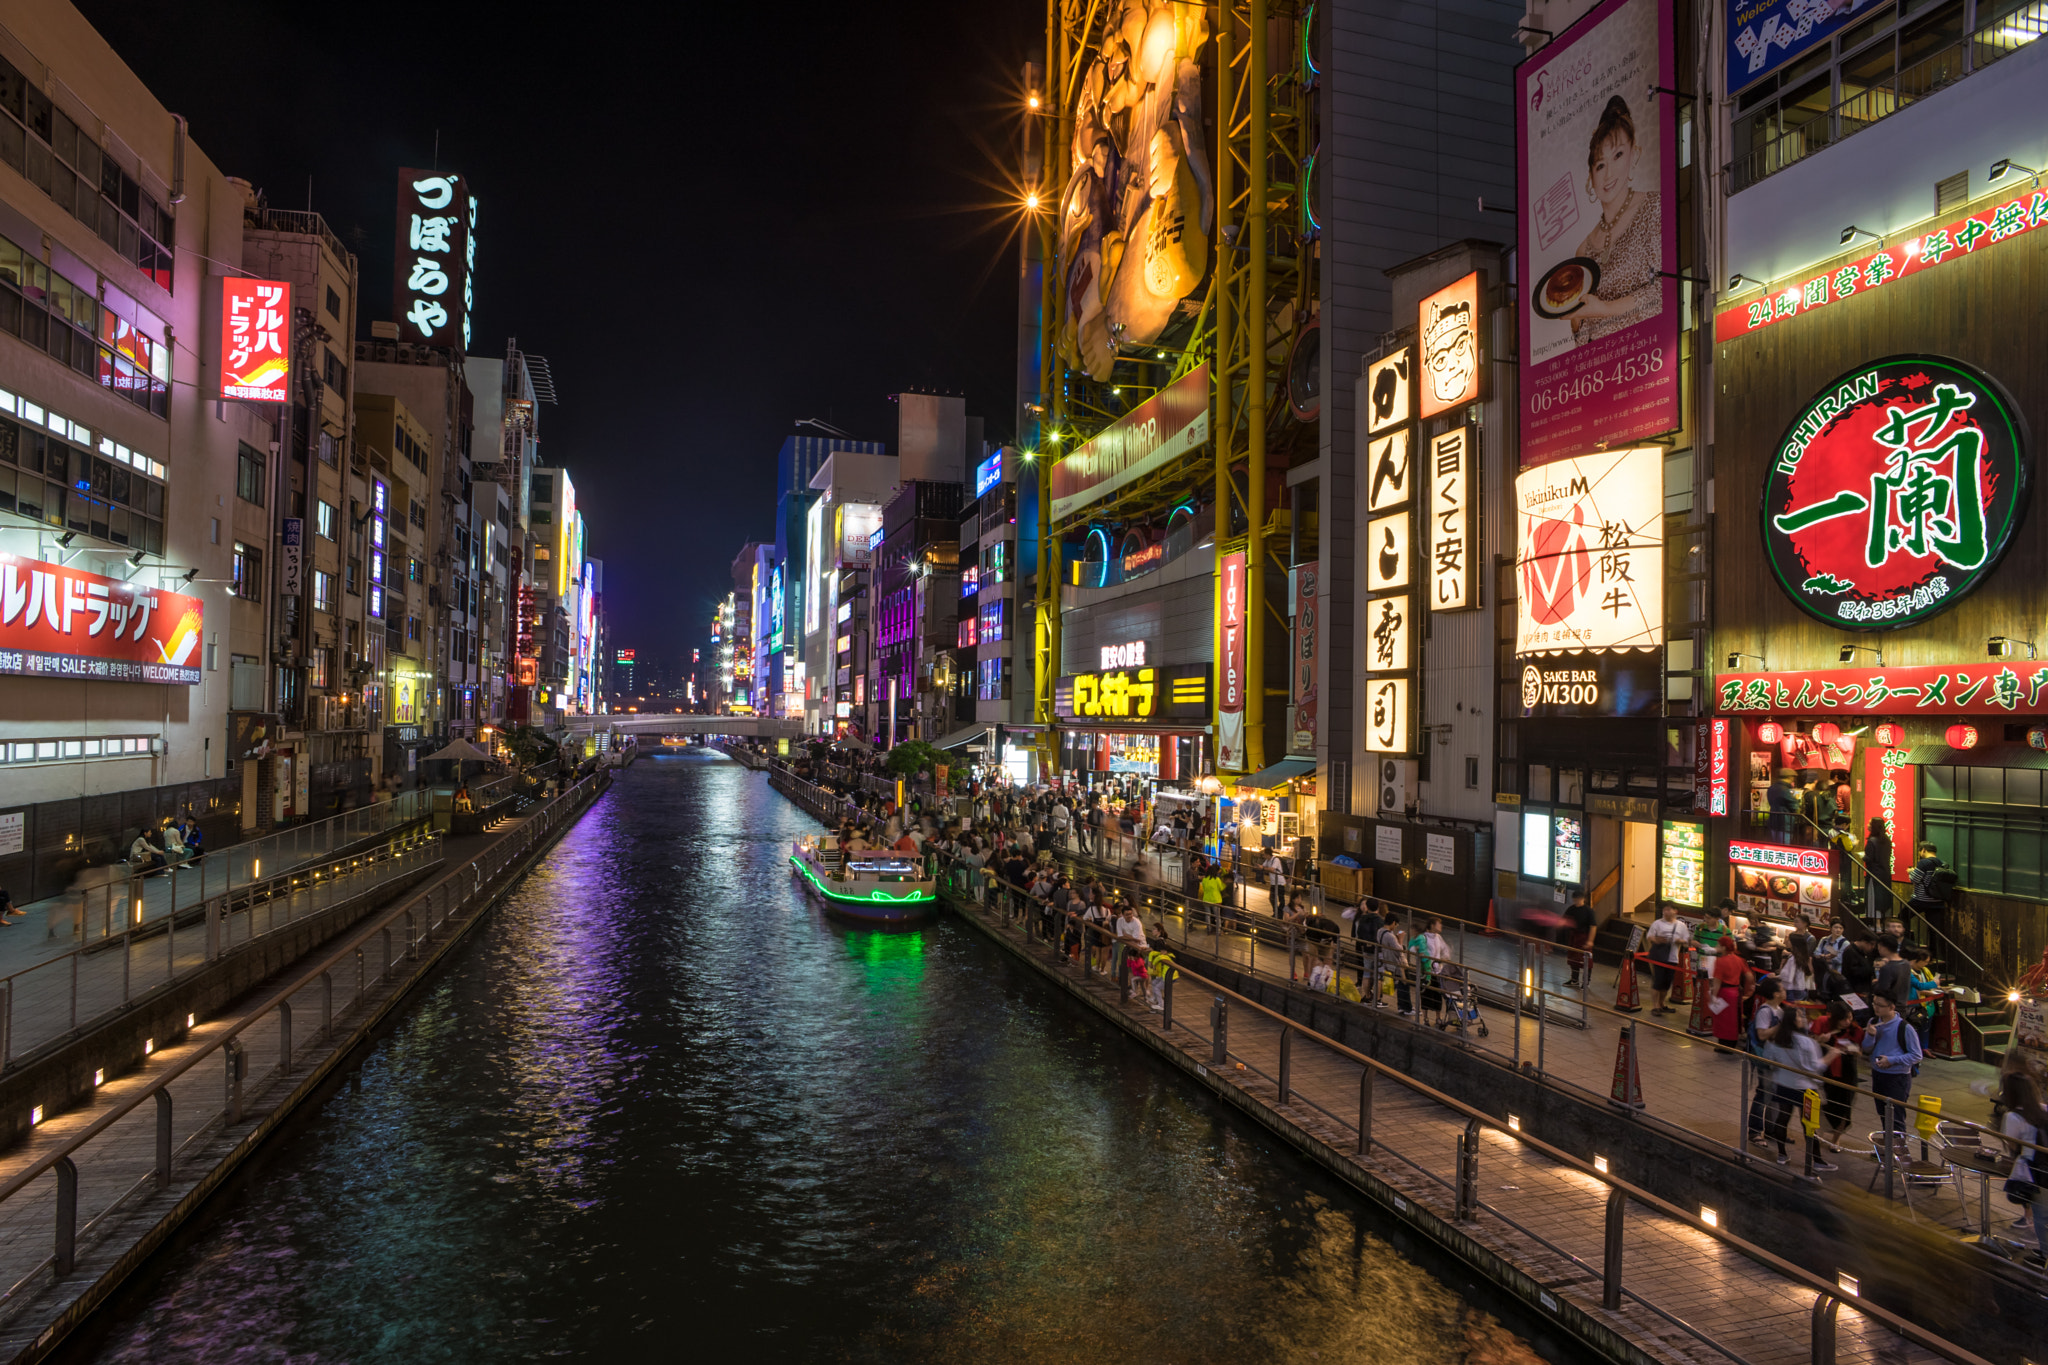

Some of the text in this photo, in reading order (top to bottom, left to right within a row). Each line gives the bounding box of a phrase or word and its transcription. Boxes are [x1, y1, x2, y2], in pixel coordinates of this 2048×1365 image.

[1736, 0, 1778, 27] Welco
[1546, 50, 1592, 89] MADAME
[1547, 63, 1592, 102] SHINCO
[407, 175, 458, 337] づぼらや
[229, 295, 254, 369] ドラッグ
[254, 286, 283, 354] ツルハ
[1531, 348, 1663, 414] 06-6468-4538
[1777, 371, 1879, 476] ICHIRAN
[1773, 383, 1988, 571] 一蘭
[286, 520, 300, 544] 焼肉
[1435, 435, 1463, 606] 旨くて安い
[1598, 518, 1635, 619] 松阪牛
[1838, 576, 1949, 621] 昭和35年創業
[0, 563, 158, 642] ルハドラッグ
[1227, 564, 1237, 703] Tax Free
[61, 657, 86, 674] SALE
[142, 665, 179, 681] WELCOME
[1542, 684, 1598, 705] M300
[1543, 671, 1597, 682] SAKE BAR
[1729, 845, 1799, 868] お土産販売所
